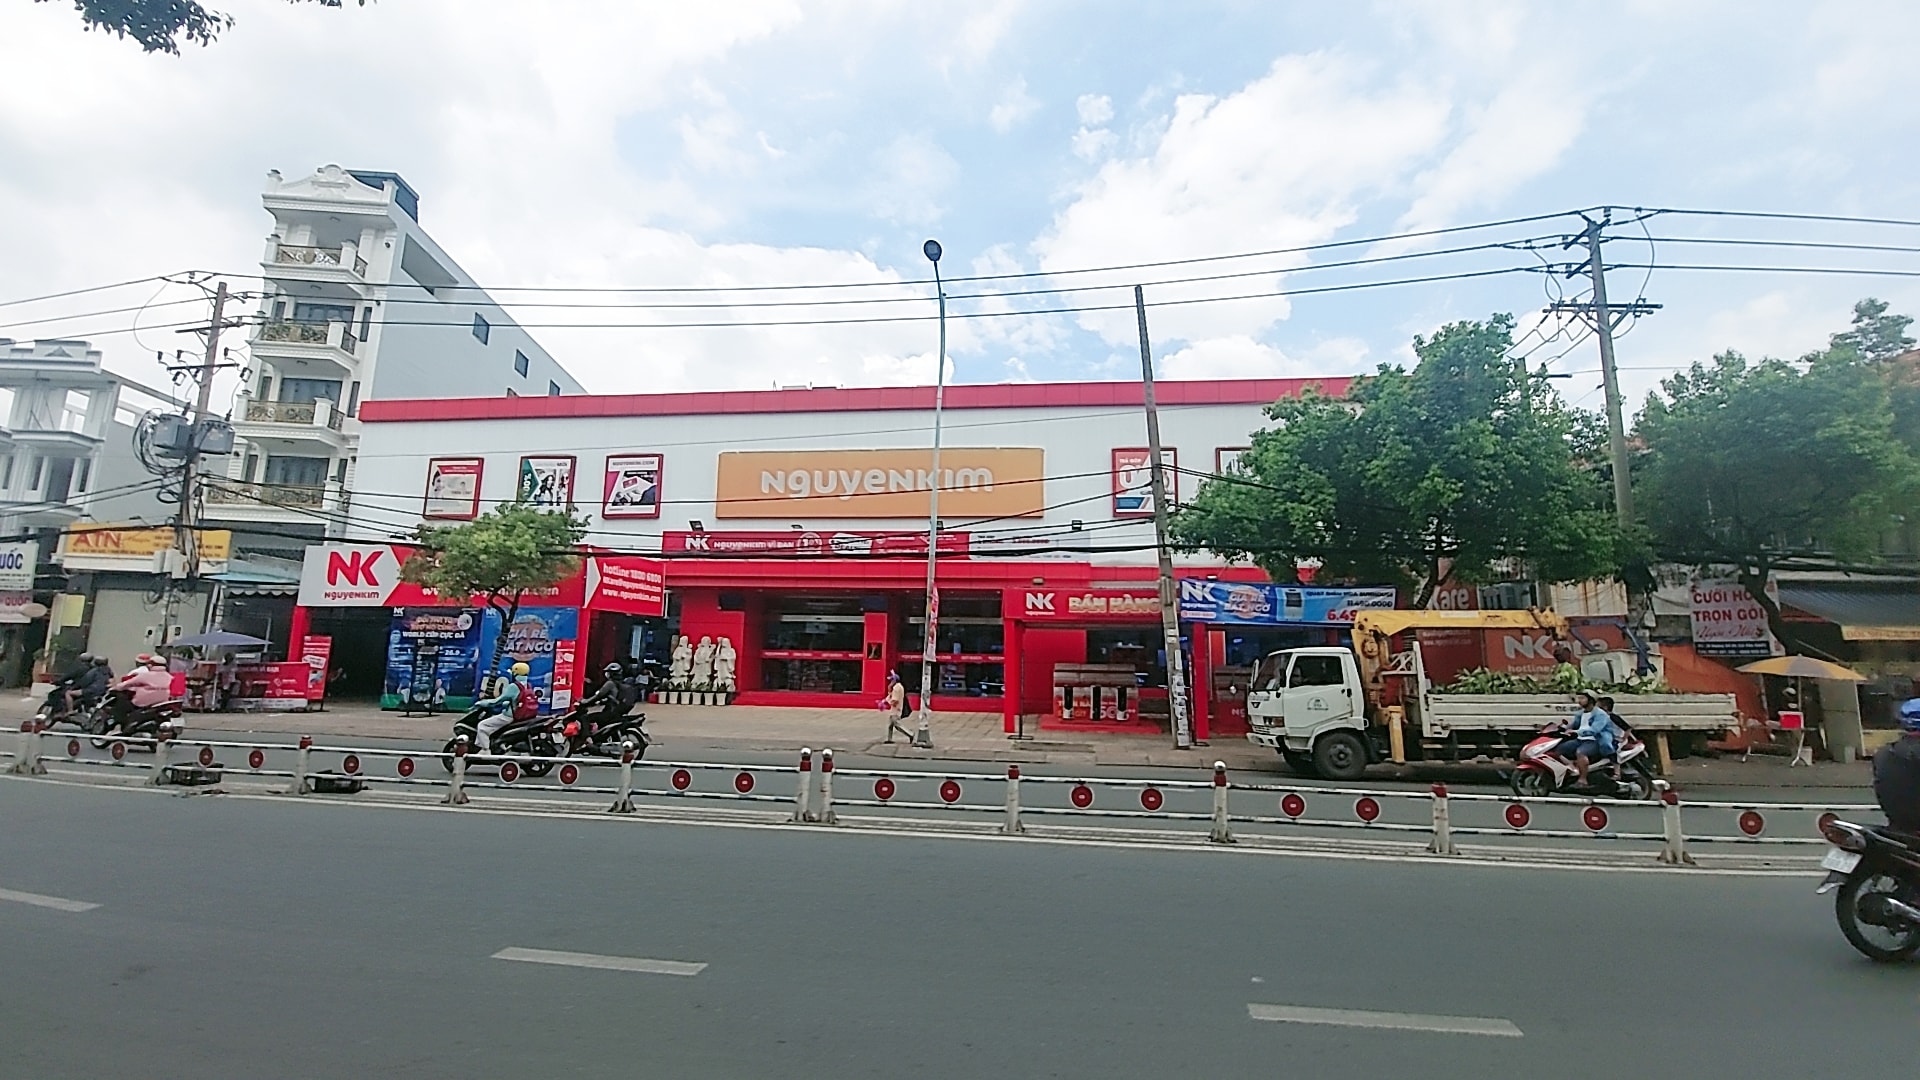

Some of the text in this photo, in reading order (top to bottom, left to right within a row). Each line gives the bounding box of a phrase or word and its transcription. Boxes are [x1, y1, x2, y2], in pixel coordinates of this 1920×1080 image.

[684, 535, 712, 550] NK
[326, 550, 385, 587] NK
[603, 562, 630, 578] hotline
[1181, 580, 1217, 602] NK
[1026, 592, 1162, 613] NK BÁN HÀNG
